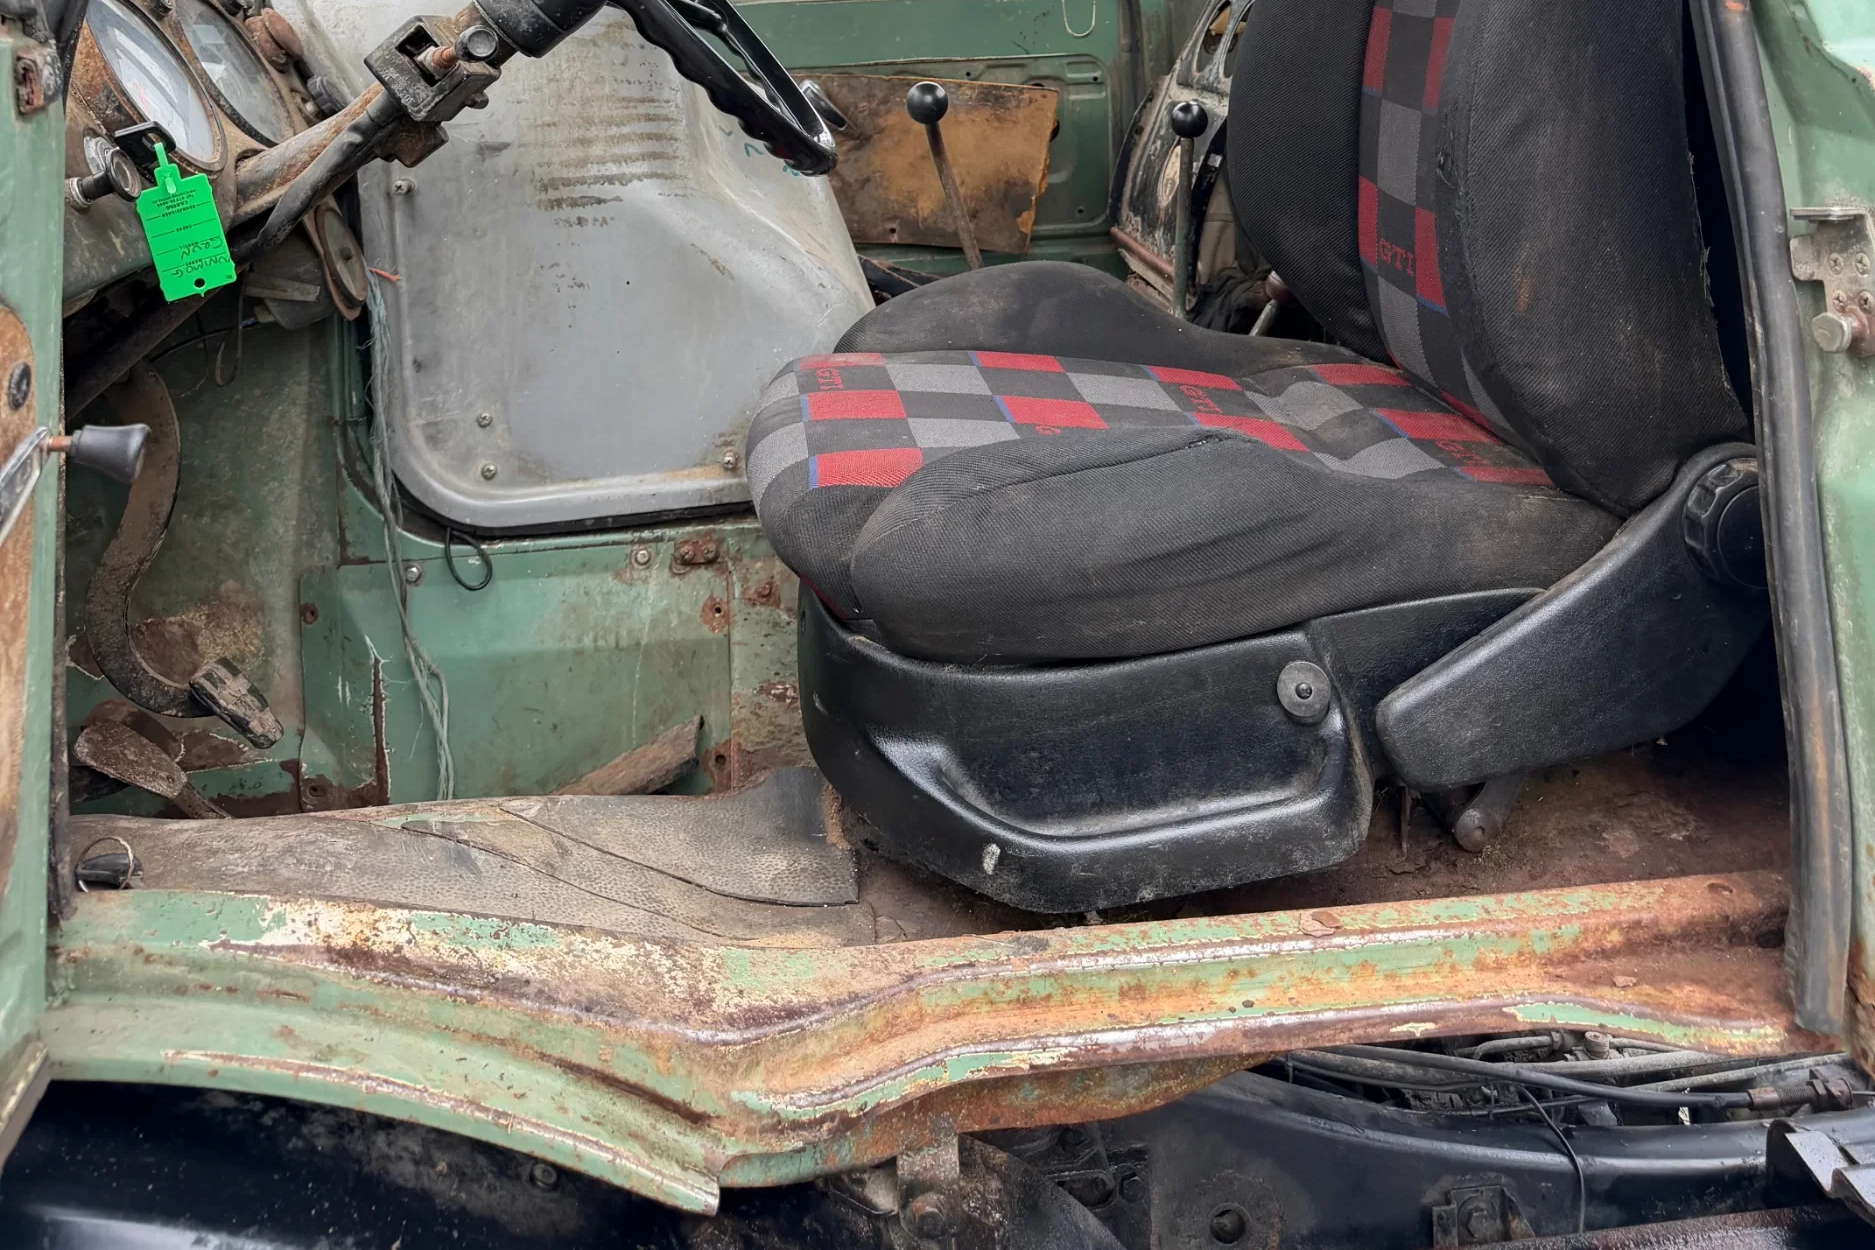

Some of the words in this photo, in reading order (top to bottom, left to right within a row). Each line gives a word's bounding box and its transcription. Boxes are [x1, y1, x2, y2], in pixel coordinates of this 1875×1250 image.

[1379, 237, 1414, 277] GTI
[816, 368, 844, 391] GTI
[1180, 384, 1223, 414] GTI
[1434, 440, 1491, 468] GTI
